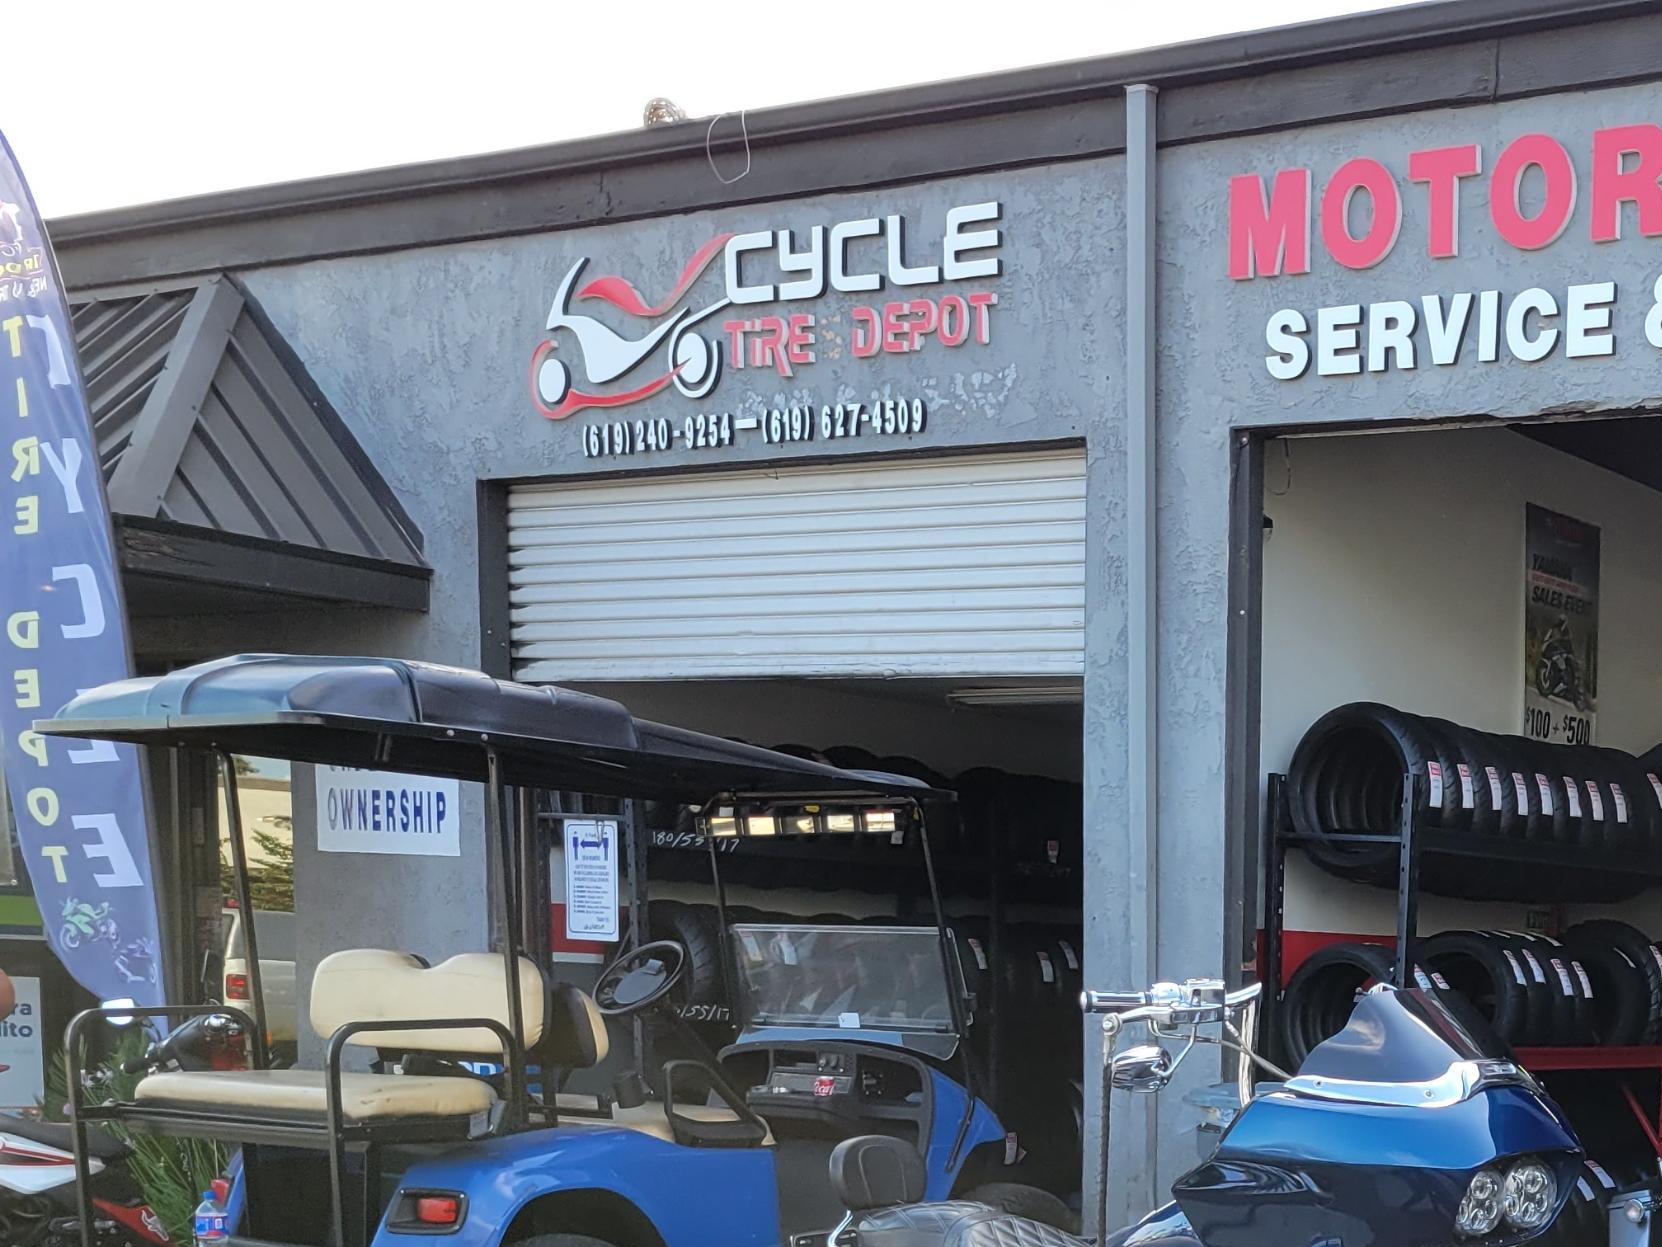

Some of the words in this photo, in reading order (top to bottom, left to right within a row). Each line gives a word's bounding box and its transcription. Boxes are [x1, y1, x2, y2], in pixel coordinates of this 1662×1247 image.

[725, 201, 1002, 304] CYCLE
[723, 313, 815, 377] TIRE
[852, 292, 998, 357] DEPOT
[1265, 281, 1616, 379] SERVICE
[1527, 706, 1550, 739] $100
[1563, 715, 1591, 745] $500
[328, 787, 446, 833] OWNERSHIP
[0, 1020, 33, 1037] ito
